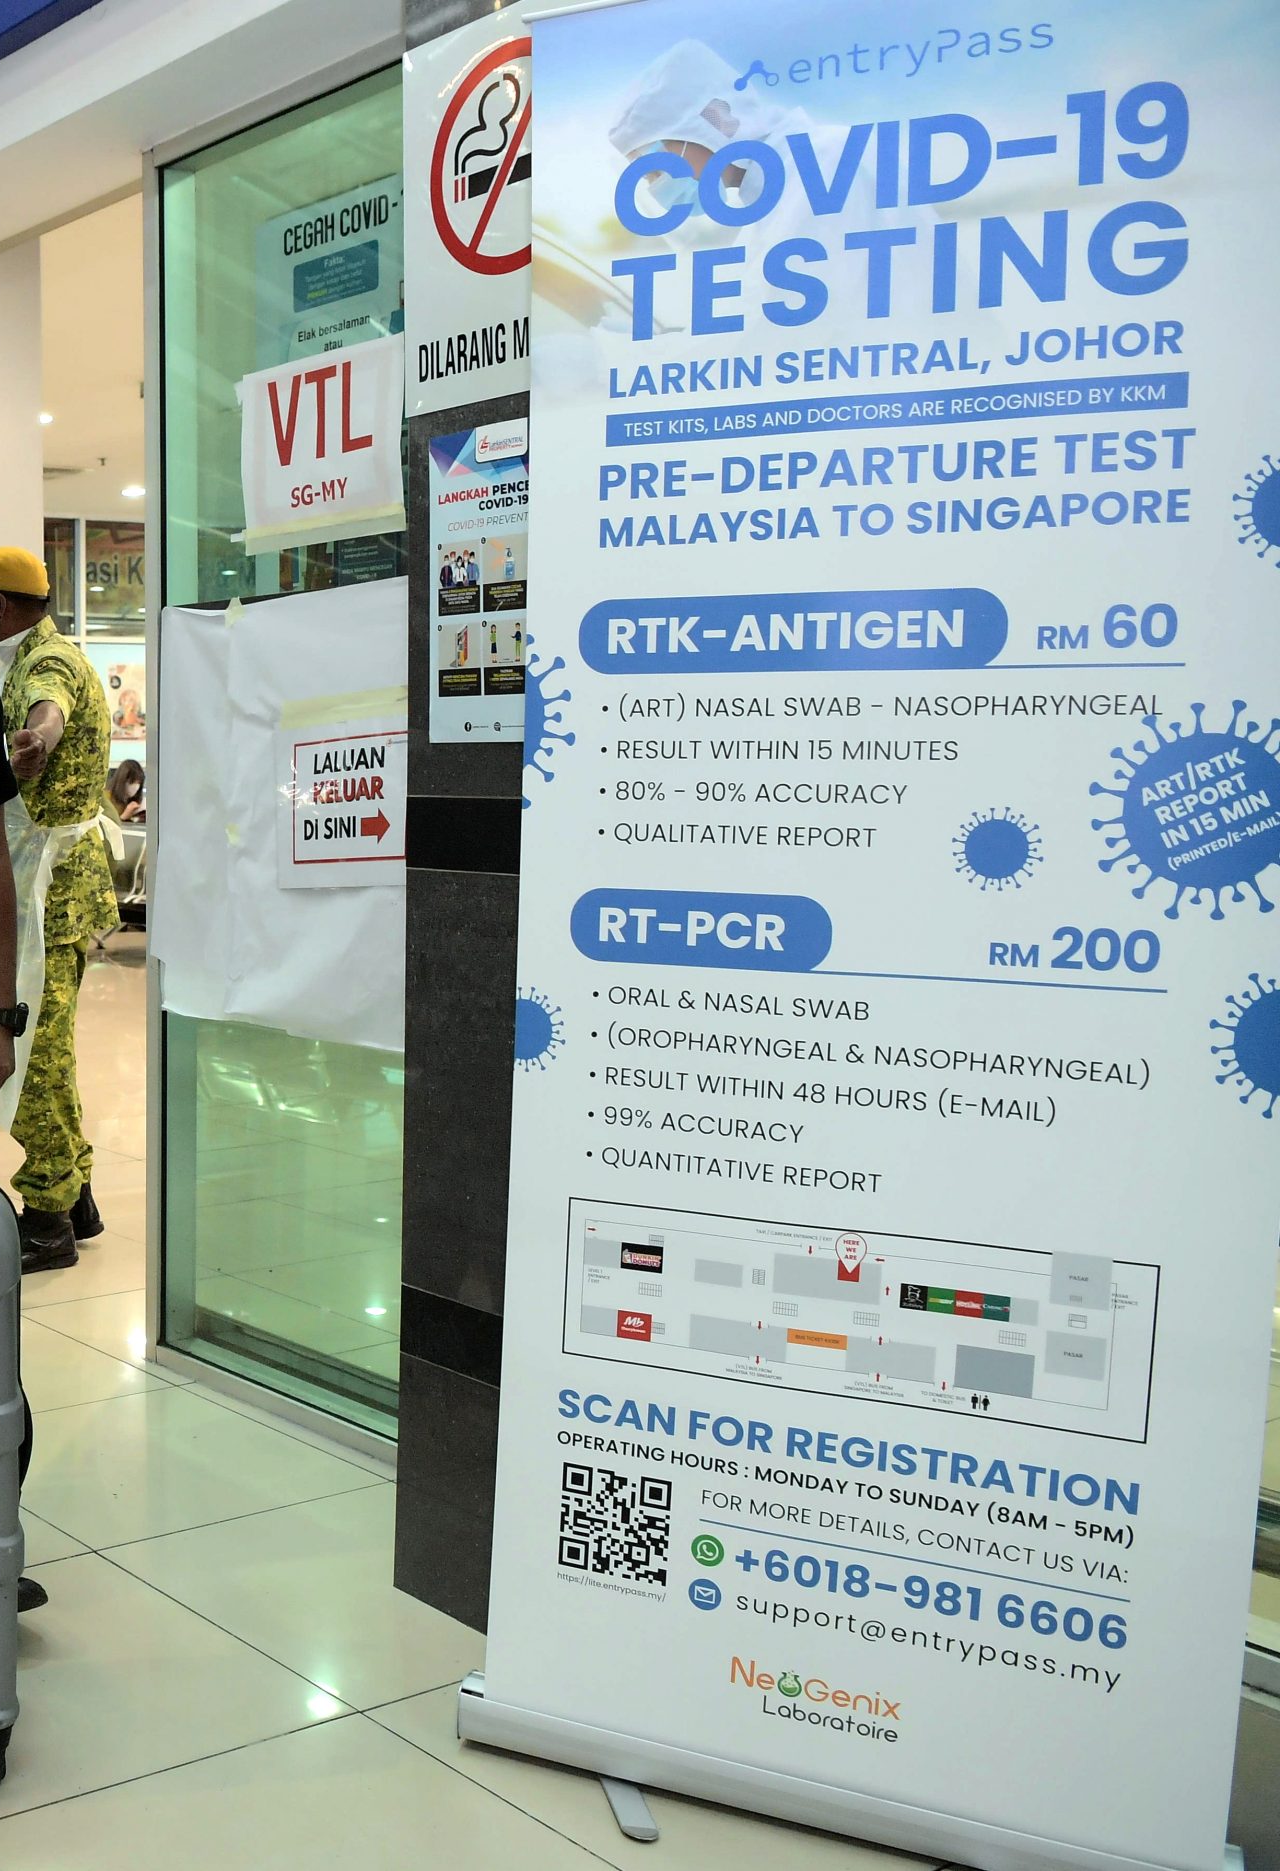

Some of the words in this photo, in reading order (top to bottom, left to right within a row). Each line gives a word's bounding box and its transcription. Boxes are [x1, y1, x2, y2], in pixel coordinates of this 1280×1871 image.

[788, 24, 1053, 83] entryPass
[614, 81, 1189, 236] COVID-19
[283, 212, 335, 256] CEGAH
[340, 194, 389, 237] COVID
[612, 202, 1189, 341] TESTING
[298, 328, 316, 343] Elak
[318, 314, 370, 337] bersalaman
[324, 338, 343, 352] atau
[419, 322, 506, 383] DILARANG
[610, 355, 762, 398] LARKIN
[776, 338, 990, 384] SENTRAL,
[1005, 321, 1184, 365] JOHOR
[267, 360, 373, 467] VTL
[624, 421, 663, 437] TEST
[669, 418, 708, 434] KITS,
[714, 414, 756, 431] LABS
[762, 410, 801, 427] AND
[808, 404, 902, 423] DOCTORS
[909, 401, 944, 417] ARE
[951, 390, 1082, 414] RECOGNISED
[1089, 388, 1114, 404] BY
[1121, 385, 1165, 401] KKM
[600, 437, 1037, 501] PRE-DEPARTURE
[1055, 428, 1196, 474] TEST
[291, 477, 348, 508] SG-MY
[438, 486, 489, 505] LANGKAH
[479, 494, 529, 511] COVID-19
[447, 519, 485, 532] COVID-19
[600, 507, 819, 548] MALAYSIA
[832, 504, 893, 536] TO
[907, 489, 1190, 534] SINGAPORE
[608, 609, 964, 654] RTK-ANTIGEN
[1037, 625, 1088, 649] RM
[1104, 603, 1177, 648] 60
[620, 694, 684, 722] (ART)
[696, 698, 774, 716] NASAL
[784, 697, 860, 716] SWAB
[895, 695, 1162, 717] NASOPHARYNGEAL
[314, 746, 385, 774] LALUAN
[618, 741, 701, 759] RESULT
[711, 741, 798, 759] WITHIN
[809, 740, 832, 759] 15
[843, 741, 957, 760] MINUTES
[314, 776, 384, 804] KELUAR
[616, 781, 665, 800] 80%
[696, 782, 745, 802] 90%
[755, 784, 907, 804] ACCURACY
[1141, 747, 1246, 806] ART/RTK
[1154, 772, 1246, 825] REPORT
[304, 819, 318, 840] DI
[324, 816, 356, 839] SINI
[615, 823, 767, 844] QUALITATIVE
[778, 827, 876, 847] REPORT
[1161, 825, 1190, 849] IN
[1189, 812, 1218, 836] 15
[1219, 790, 1271, 824] MIN
[599, 907, 785, 951] RT-PCR
[990, 943, 1039, 967] RM
[1051, 926, 1160, 973] 200
[609, 987, 670, 1007] ORAL
[678, 991, 695, 1009] &
[705, 992, 783, 1015] NASAL
[793, 998, 868, 1020] SWAB
[609, 1024, 836, 1061] (OROPHARYNGEAL
[846, 1044, 864, 1063] &
[875, 1046, 1149, 1090] NASOPHARYNGEAL)
[606, 1067, 688, 1090] RESULT
[697, 1074, 783, 1099] WITHIN
[793, 1083, 824, 1103] 48
[836, 1086, 926, 1110] HOURS
[939, 1088, 1055, 1127] (E-MAIL)
[605, 1106, 652, 1128] 99%
[661, 1113, 803, 1143] ACCURACY
[602, 1147, 774, 1182] QUANTITATIVE
[784, 1166, 881, 1192] REPORT
[558, 1390, 675, 1435] SCAN
[689, 1411, 773, 1453] FOR
[787, 1427, 1139, 1515] REGISTRATION
[558, 1431, 664, 1461] OPERATING
[671, 1451, 737, 1475] HOURS
[755, 1466, 848, 1494] MONDAY
[855, 1483, 882, 1499] TO
[890, 1489, 979, 1516] SUNDAY
[988, 1502, 1047, 1530] (8AM
[1075, 1521, 1133, 1549] 5PM)
[702, 1490, 741, 1511] FOR
[750, 1499, 811, 1524] MORE
[820, 1512, 909, 1544] DETAILS,
[918, 1530, 1035, 1564] CONTACT
[1044, 1552, 1073, 1572] US
[1083, 1559, 1128, 1583] VIA:
[736, 1550, 981, 1621] +6018-981
[998, 1594, 1126, 1649] 6606
[737, 1596, 1120, 1693] support@entrypass.my
[763, 1695, 898, 1742] Laboratoire
